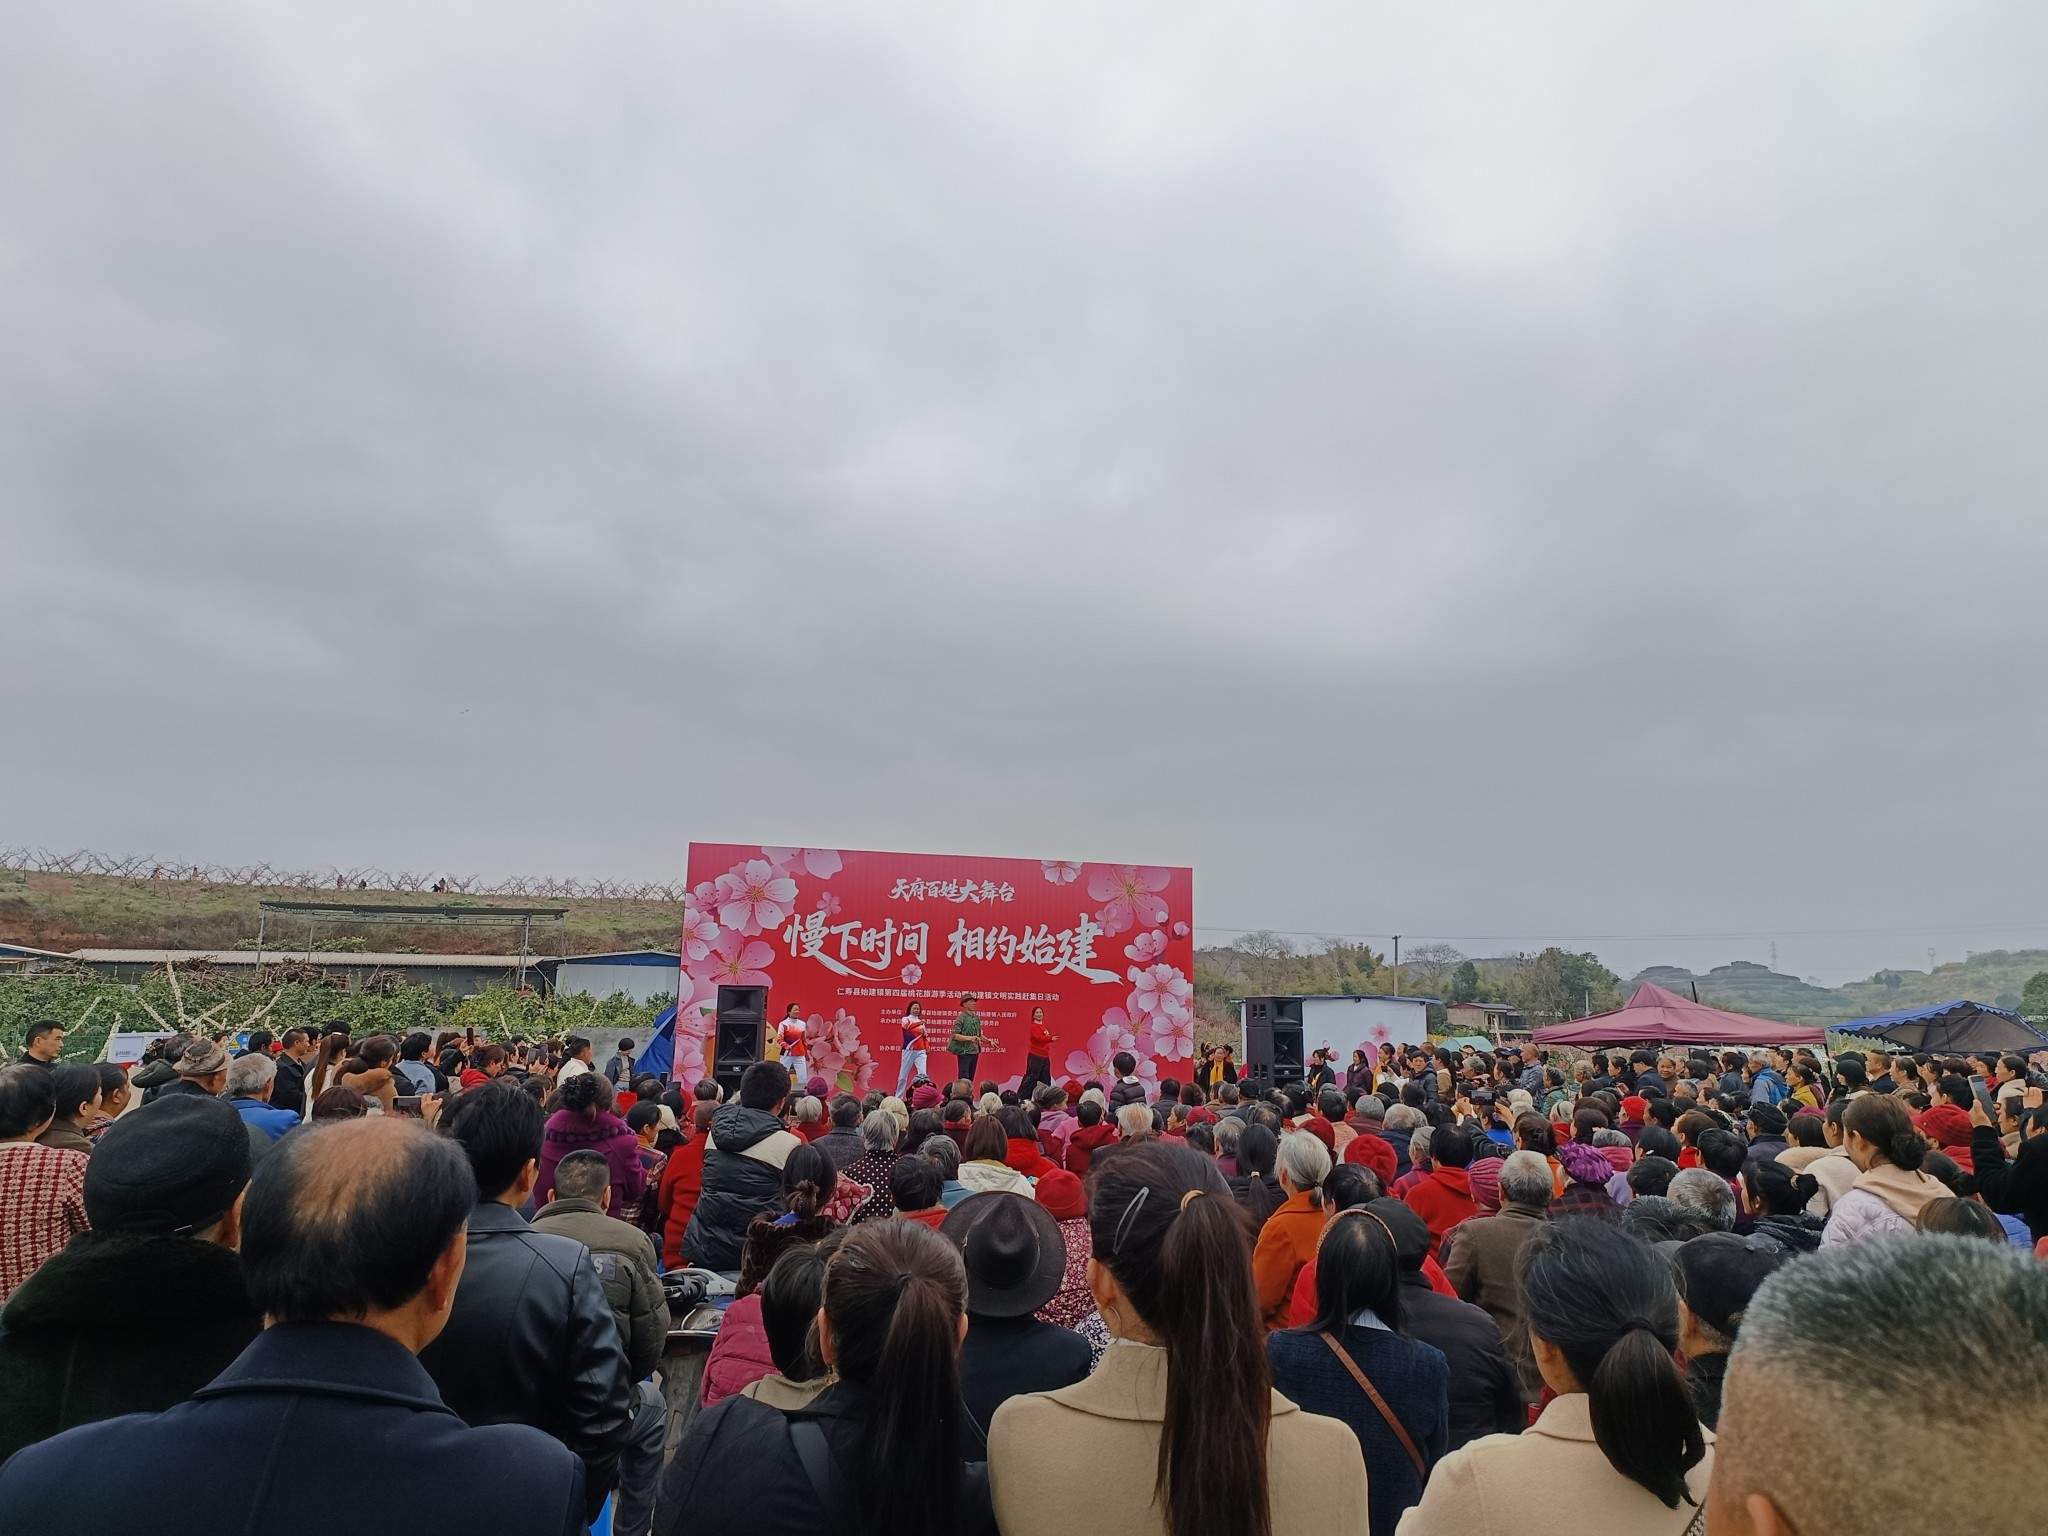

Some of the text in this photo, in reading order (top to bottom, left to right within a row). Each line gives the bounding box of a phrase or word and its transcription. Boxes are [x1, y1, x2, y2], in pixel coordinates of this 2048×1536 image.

[887, 877, 1015, 907] 天府百姓大舞台
[782, 909, 1125, 986] 慢下时间 相约始建
